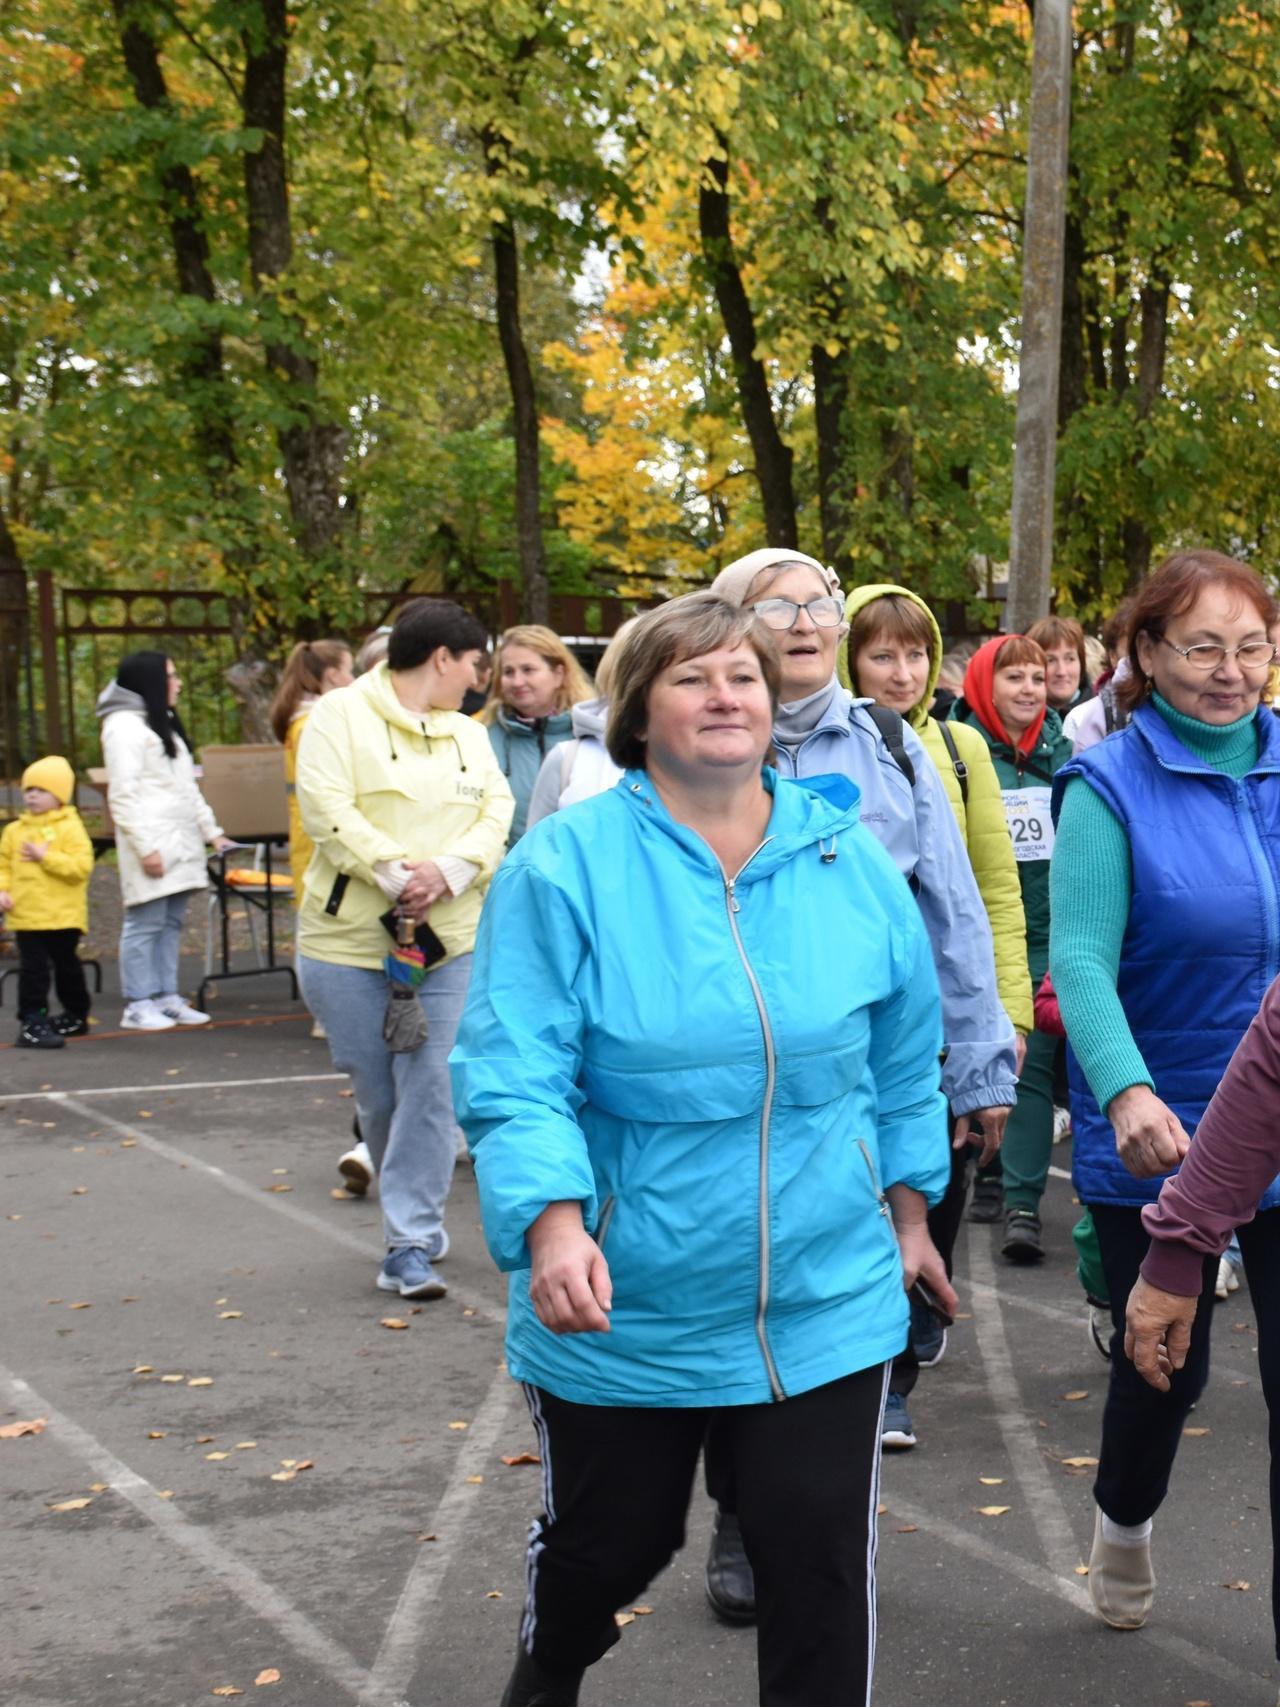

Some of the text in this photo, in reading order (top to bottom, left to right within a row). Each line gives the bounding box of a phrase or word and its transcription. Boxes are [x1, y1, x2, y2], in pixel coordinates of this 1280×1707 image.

[1006, 817, 1043, 843] 29
[1013, 843, 1047, 853] ОГОДСКАЯ
[1014, 851, 1040, 859] ЛАСТЬ
